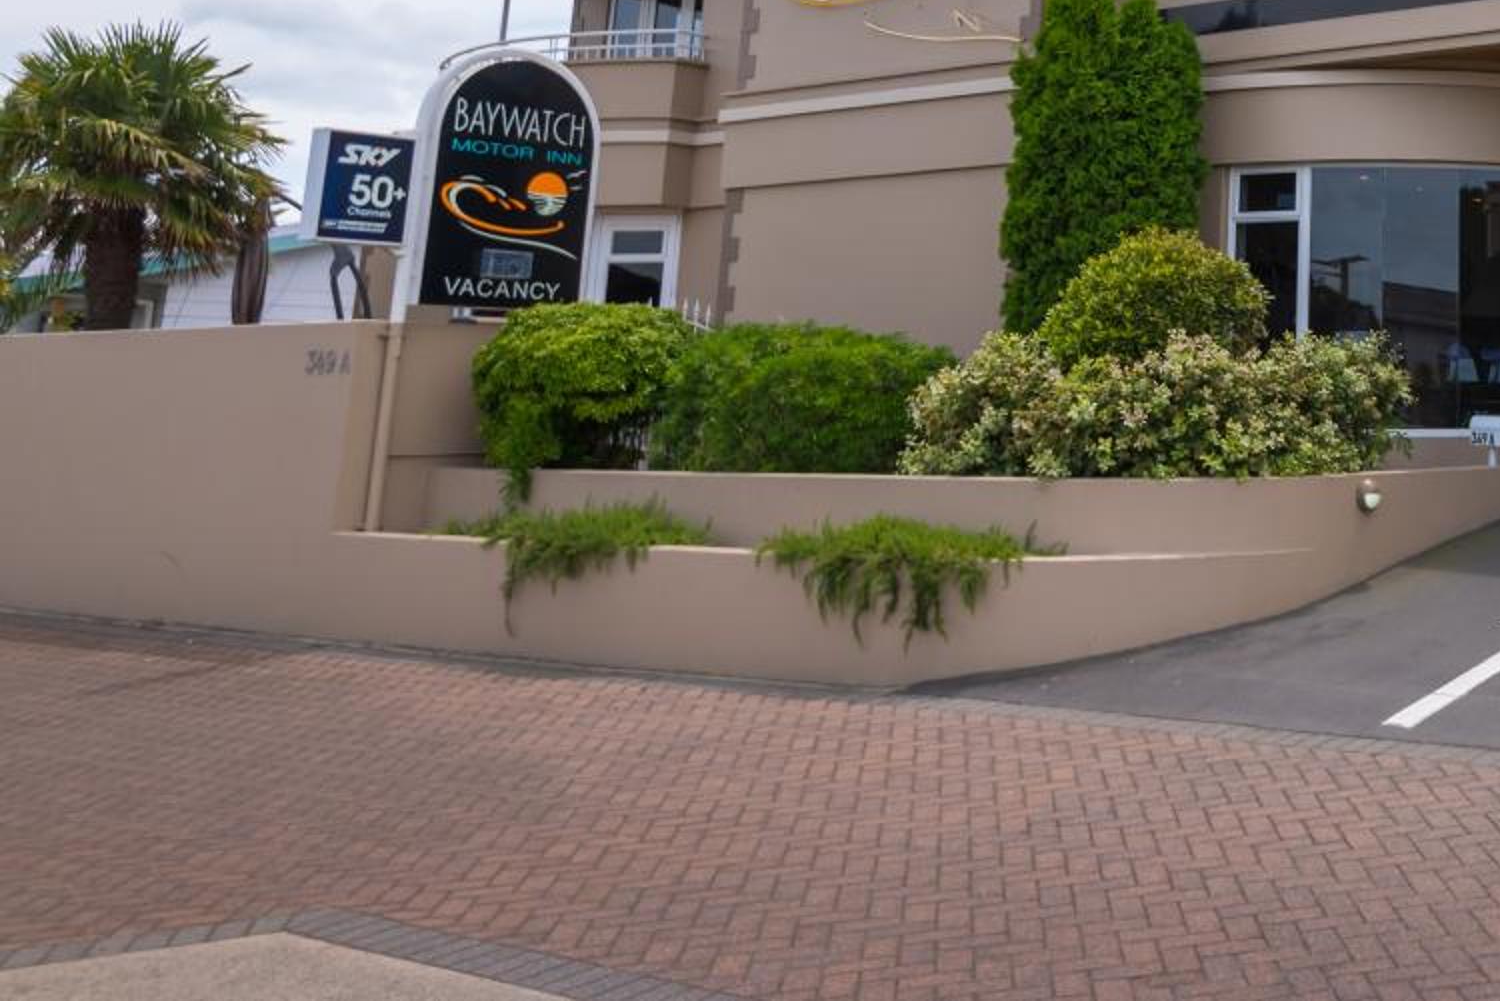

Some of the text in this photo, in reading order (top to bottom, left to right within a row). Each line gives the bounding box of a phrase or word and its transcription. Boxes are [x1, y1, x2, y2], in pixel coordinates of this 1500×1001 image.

[454, 96, 586, 149] BAYWATCH
[337, 144, 401, 167] SKY
[451, 137, 584, 166] MOTOR INN
[349, 173, 407, 209] 50+
[444, 275, 560, 300] VACANCY
